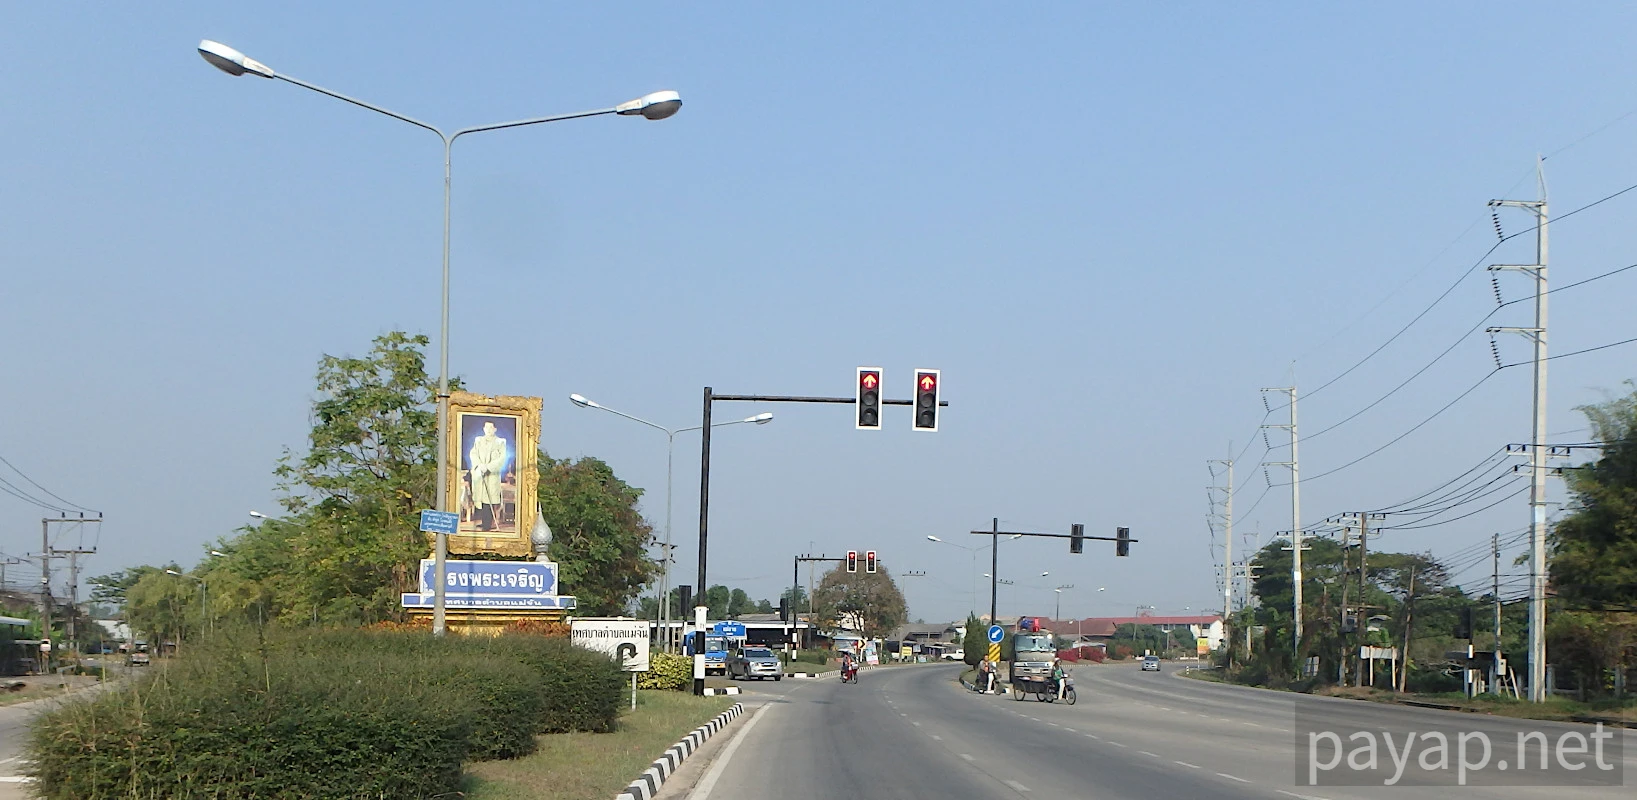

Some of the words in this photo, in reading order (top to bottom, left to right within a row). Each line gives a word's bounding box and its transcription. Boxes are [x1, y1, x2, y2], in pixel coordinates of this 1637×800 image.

[433, 568, 544, 592] รงพระเจริญ
[445, 598, 542, 606] ทศบาลตำบลแม่จัน
[572, 625, 649, 639] เทศบาลตำบลแม่จัน
